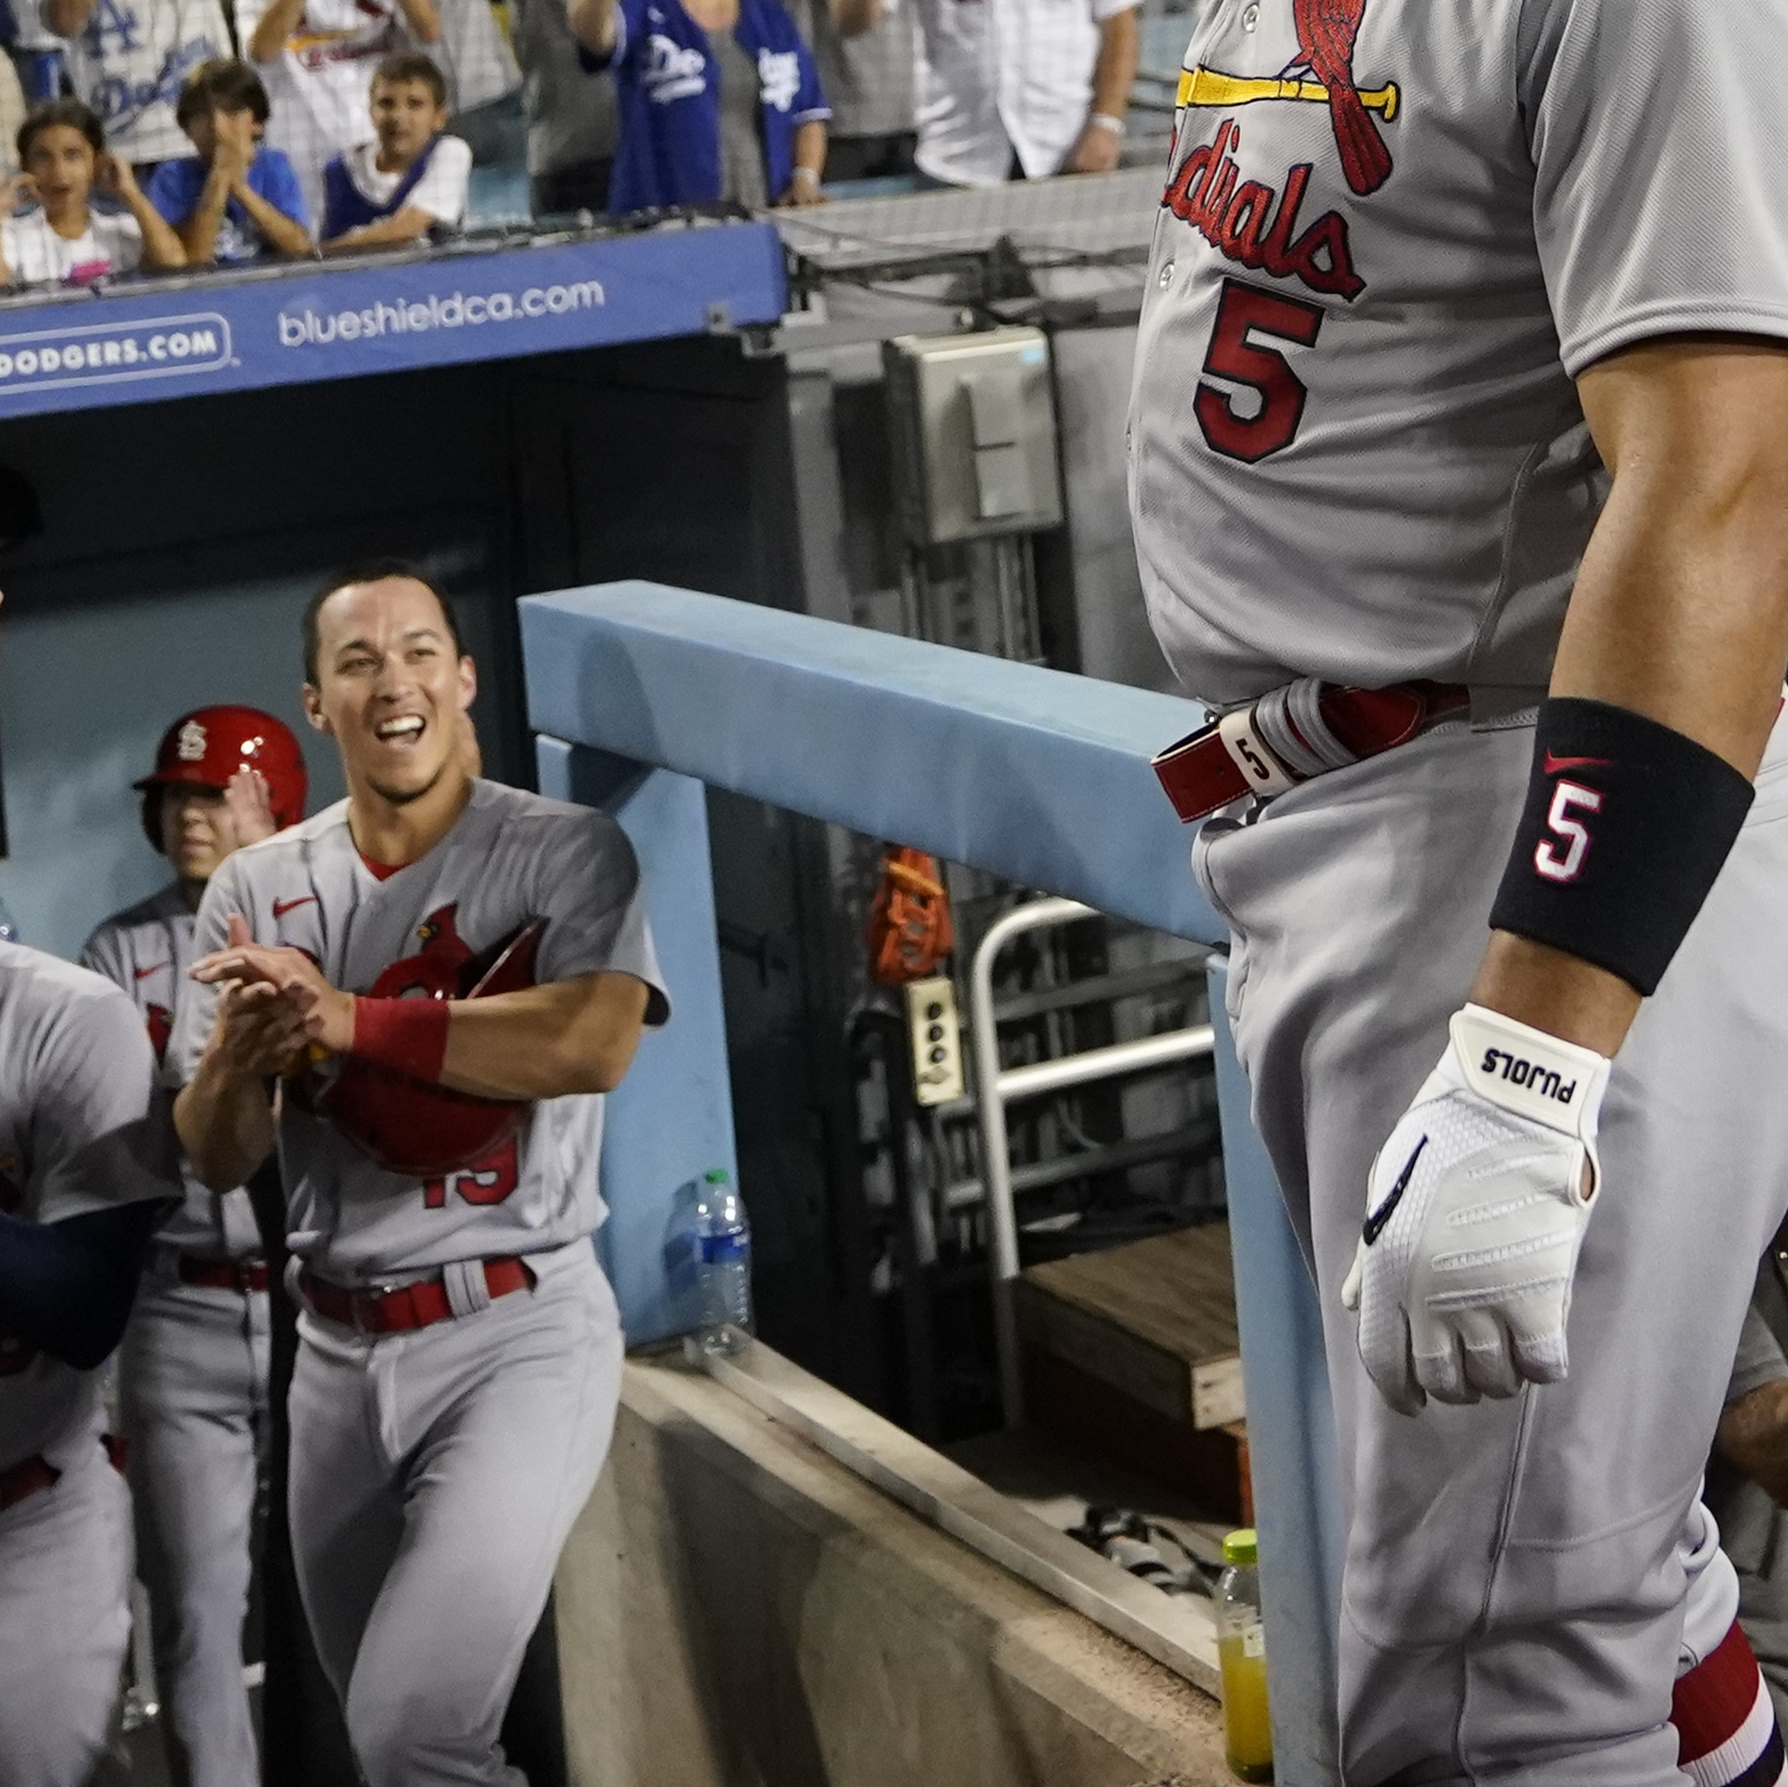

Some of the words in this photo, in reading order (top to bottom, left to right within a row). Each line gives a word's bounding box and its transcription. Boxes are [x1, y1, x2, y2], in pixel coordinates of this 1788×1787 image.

[278, 278, 605, 349] blueshieldca.com
[1192, 275, 1326, 465] 5
[1235, 737, 1270, 781] 5
[1533, 778, 1605, 886] 5
[1480, 1048, 1577, 1105] PUJOLS
